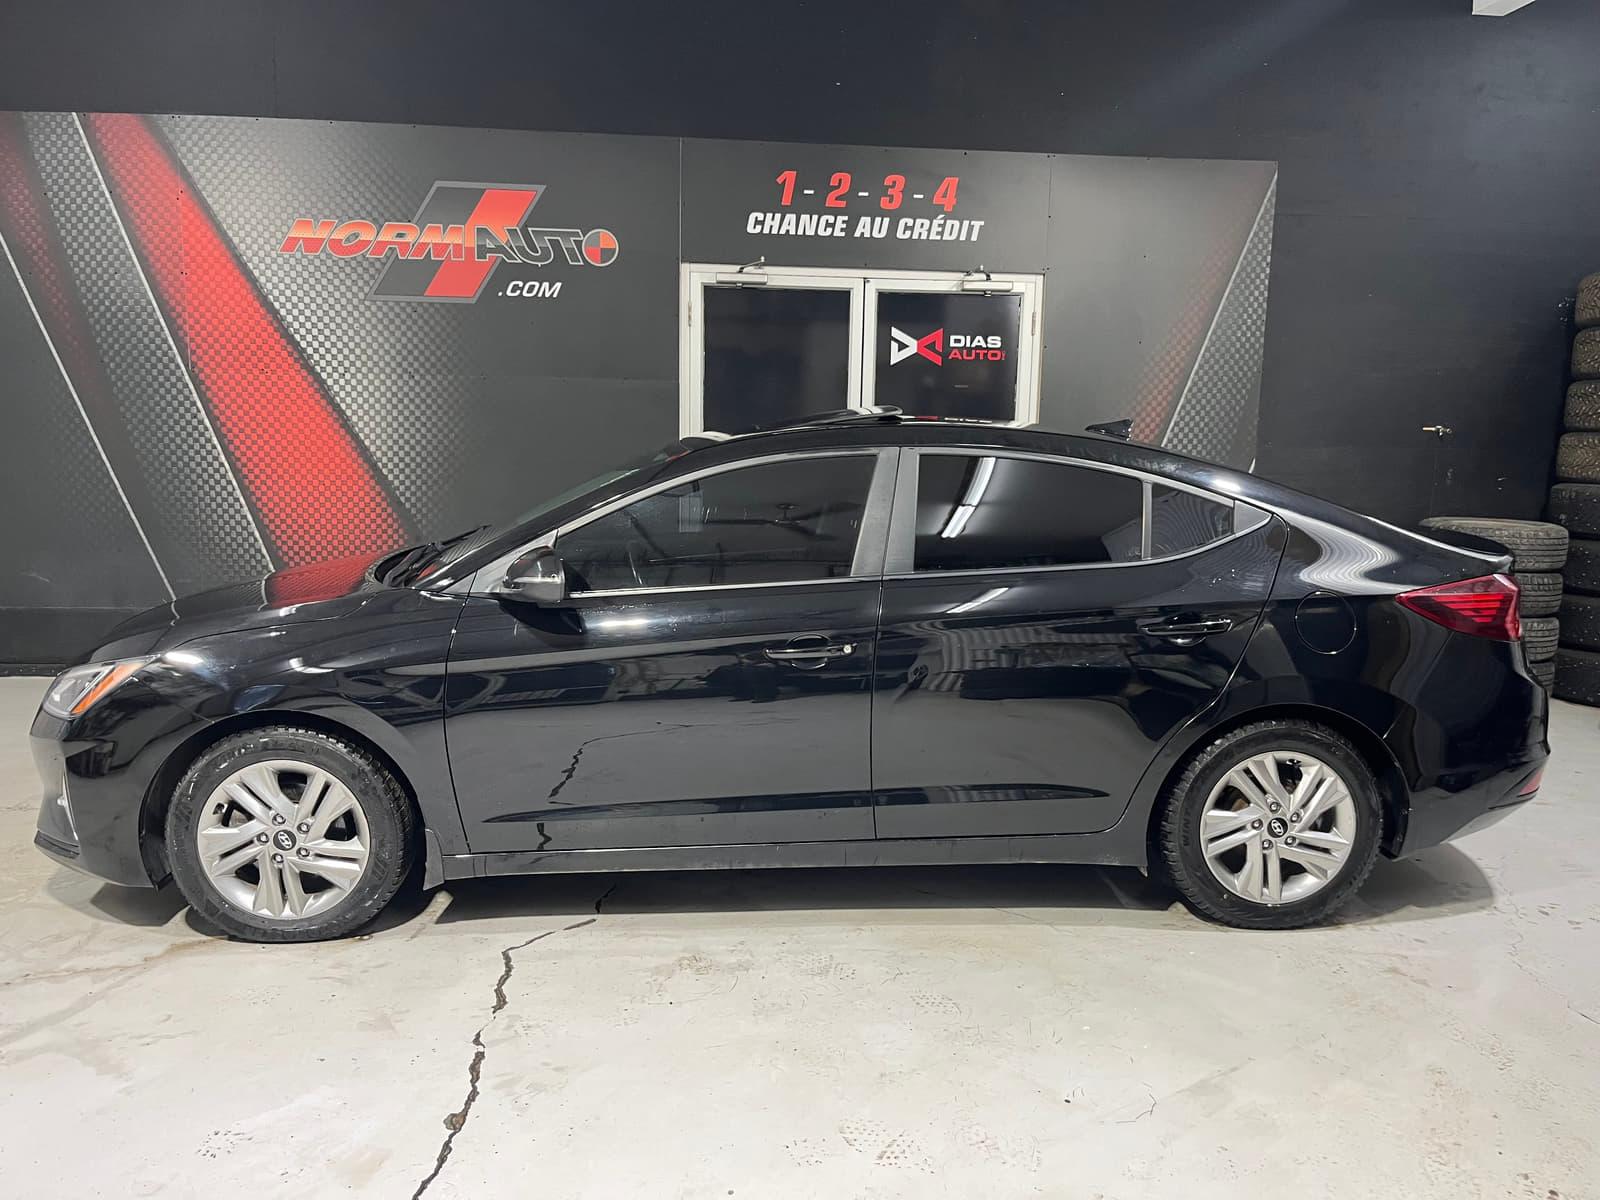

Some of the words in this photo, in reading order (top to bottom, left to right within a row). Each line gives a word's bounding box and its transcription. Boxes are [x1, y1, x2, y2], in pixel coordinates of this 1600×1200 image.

[746, 211, 849, 237] CHANCE
[853, 216, 891, 239] AU
[896, 214, 985, 242] CRÉDIT
[949, 335, 1002, 348] DIAS
